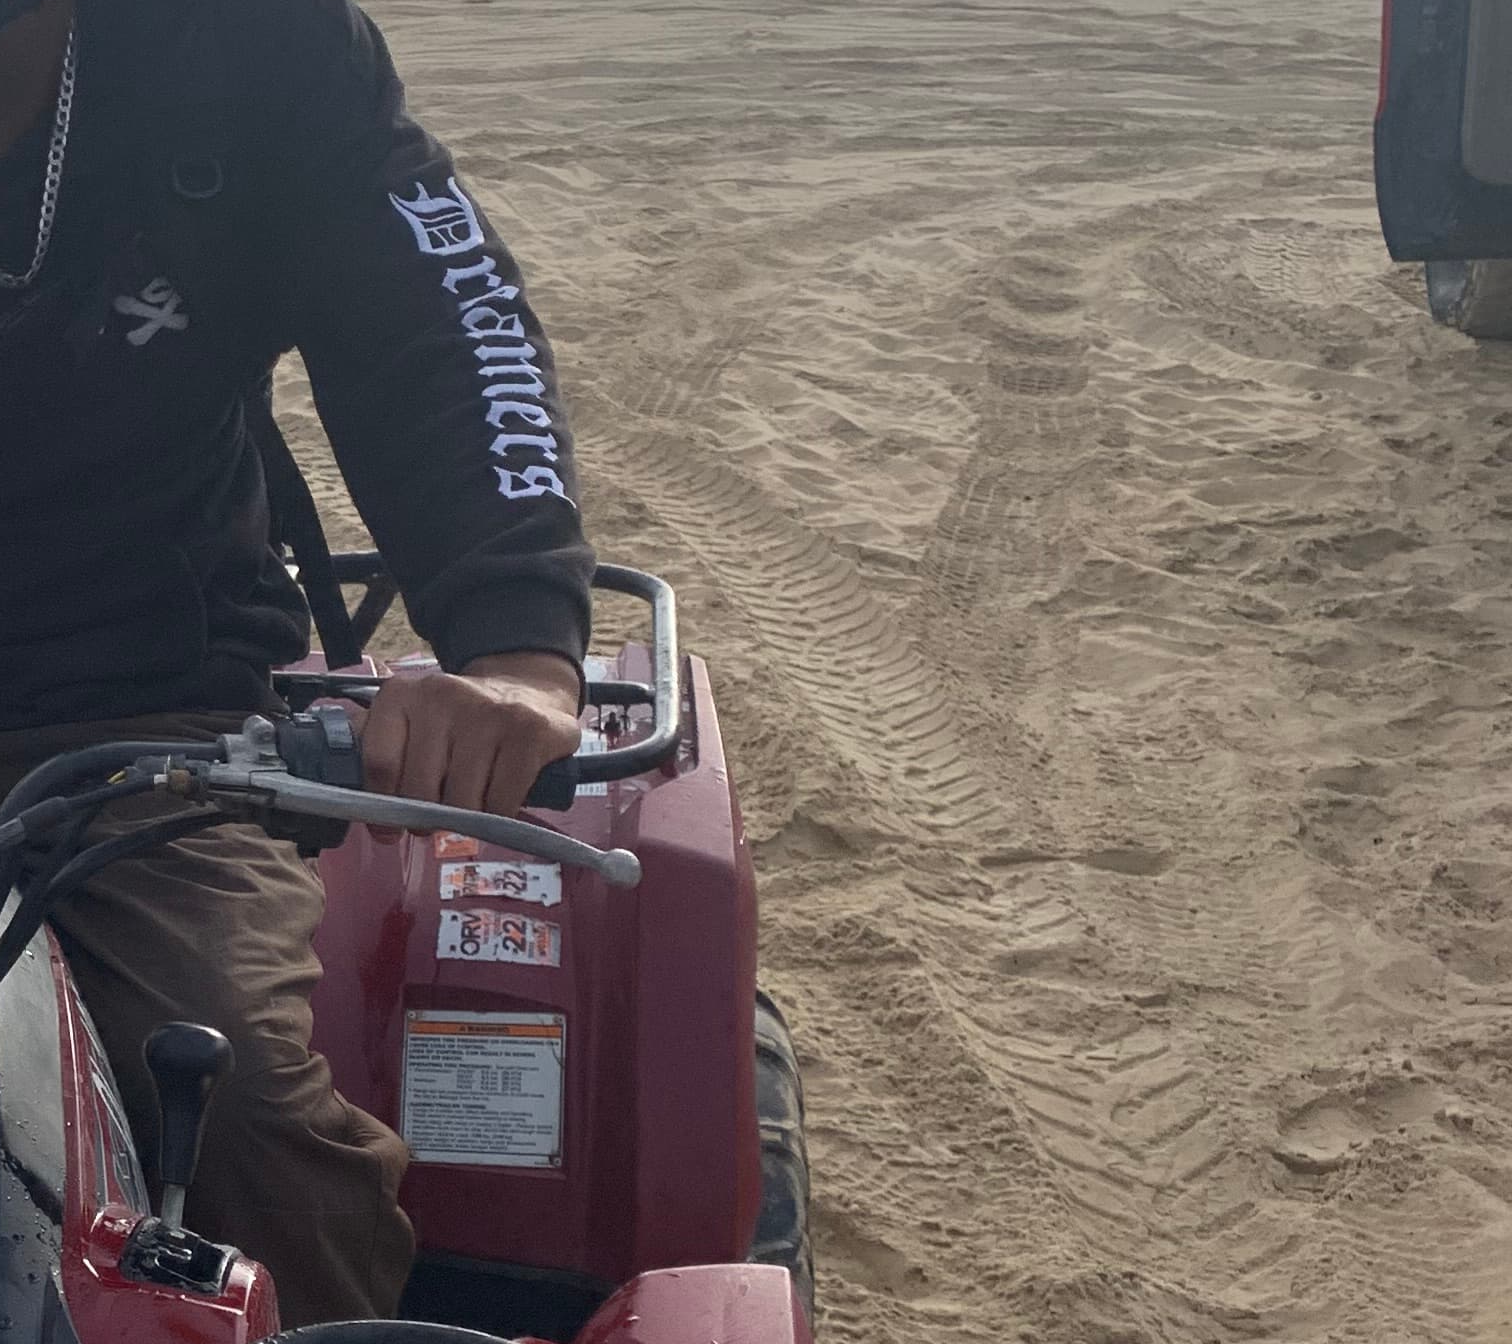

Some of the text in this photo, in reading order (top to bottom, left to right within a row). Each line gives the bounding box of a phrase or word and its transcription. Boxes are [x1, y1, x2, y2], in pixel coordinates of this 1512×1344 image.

[388, 176, 576, 509] Dreamers
[460, 913, 481, 956] ORV
[502, 920, 526, 953] 22
